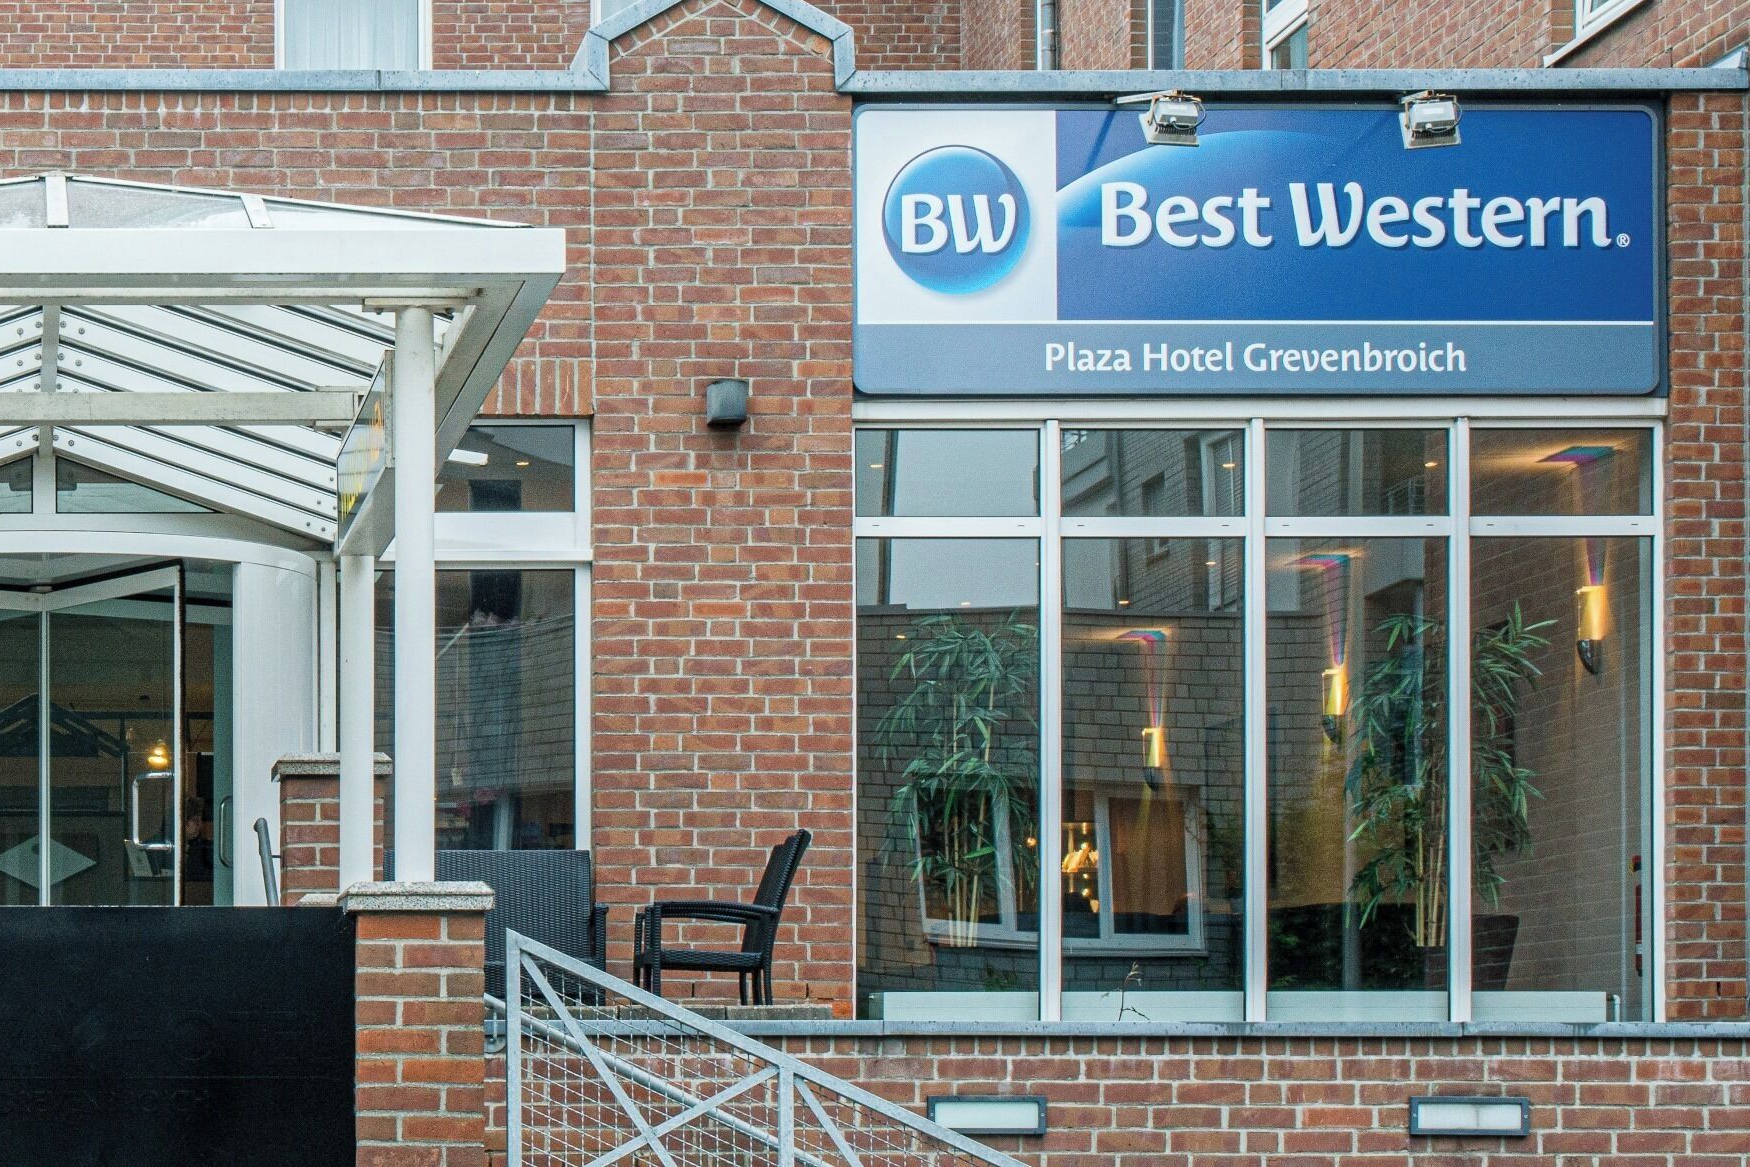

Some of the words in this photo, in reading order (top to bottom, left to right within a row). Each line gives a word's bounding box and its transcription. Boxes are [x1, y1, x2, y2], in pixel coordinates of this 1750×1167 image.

[900, 192, 1017, 254] BW
[1100, 180, 1273, 248] Best
[1044, 340, 1133, 373] Plaza
[1142, 340, 1235, 373] Hotel
[1242, 341, 1468, 373] Grevenbroich
